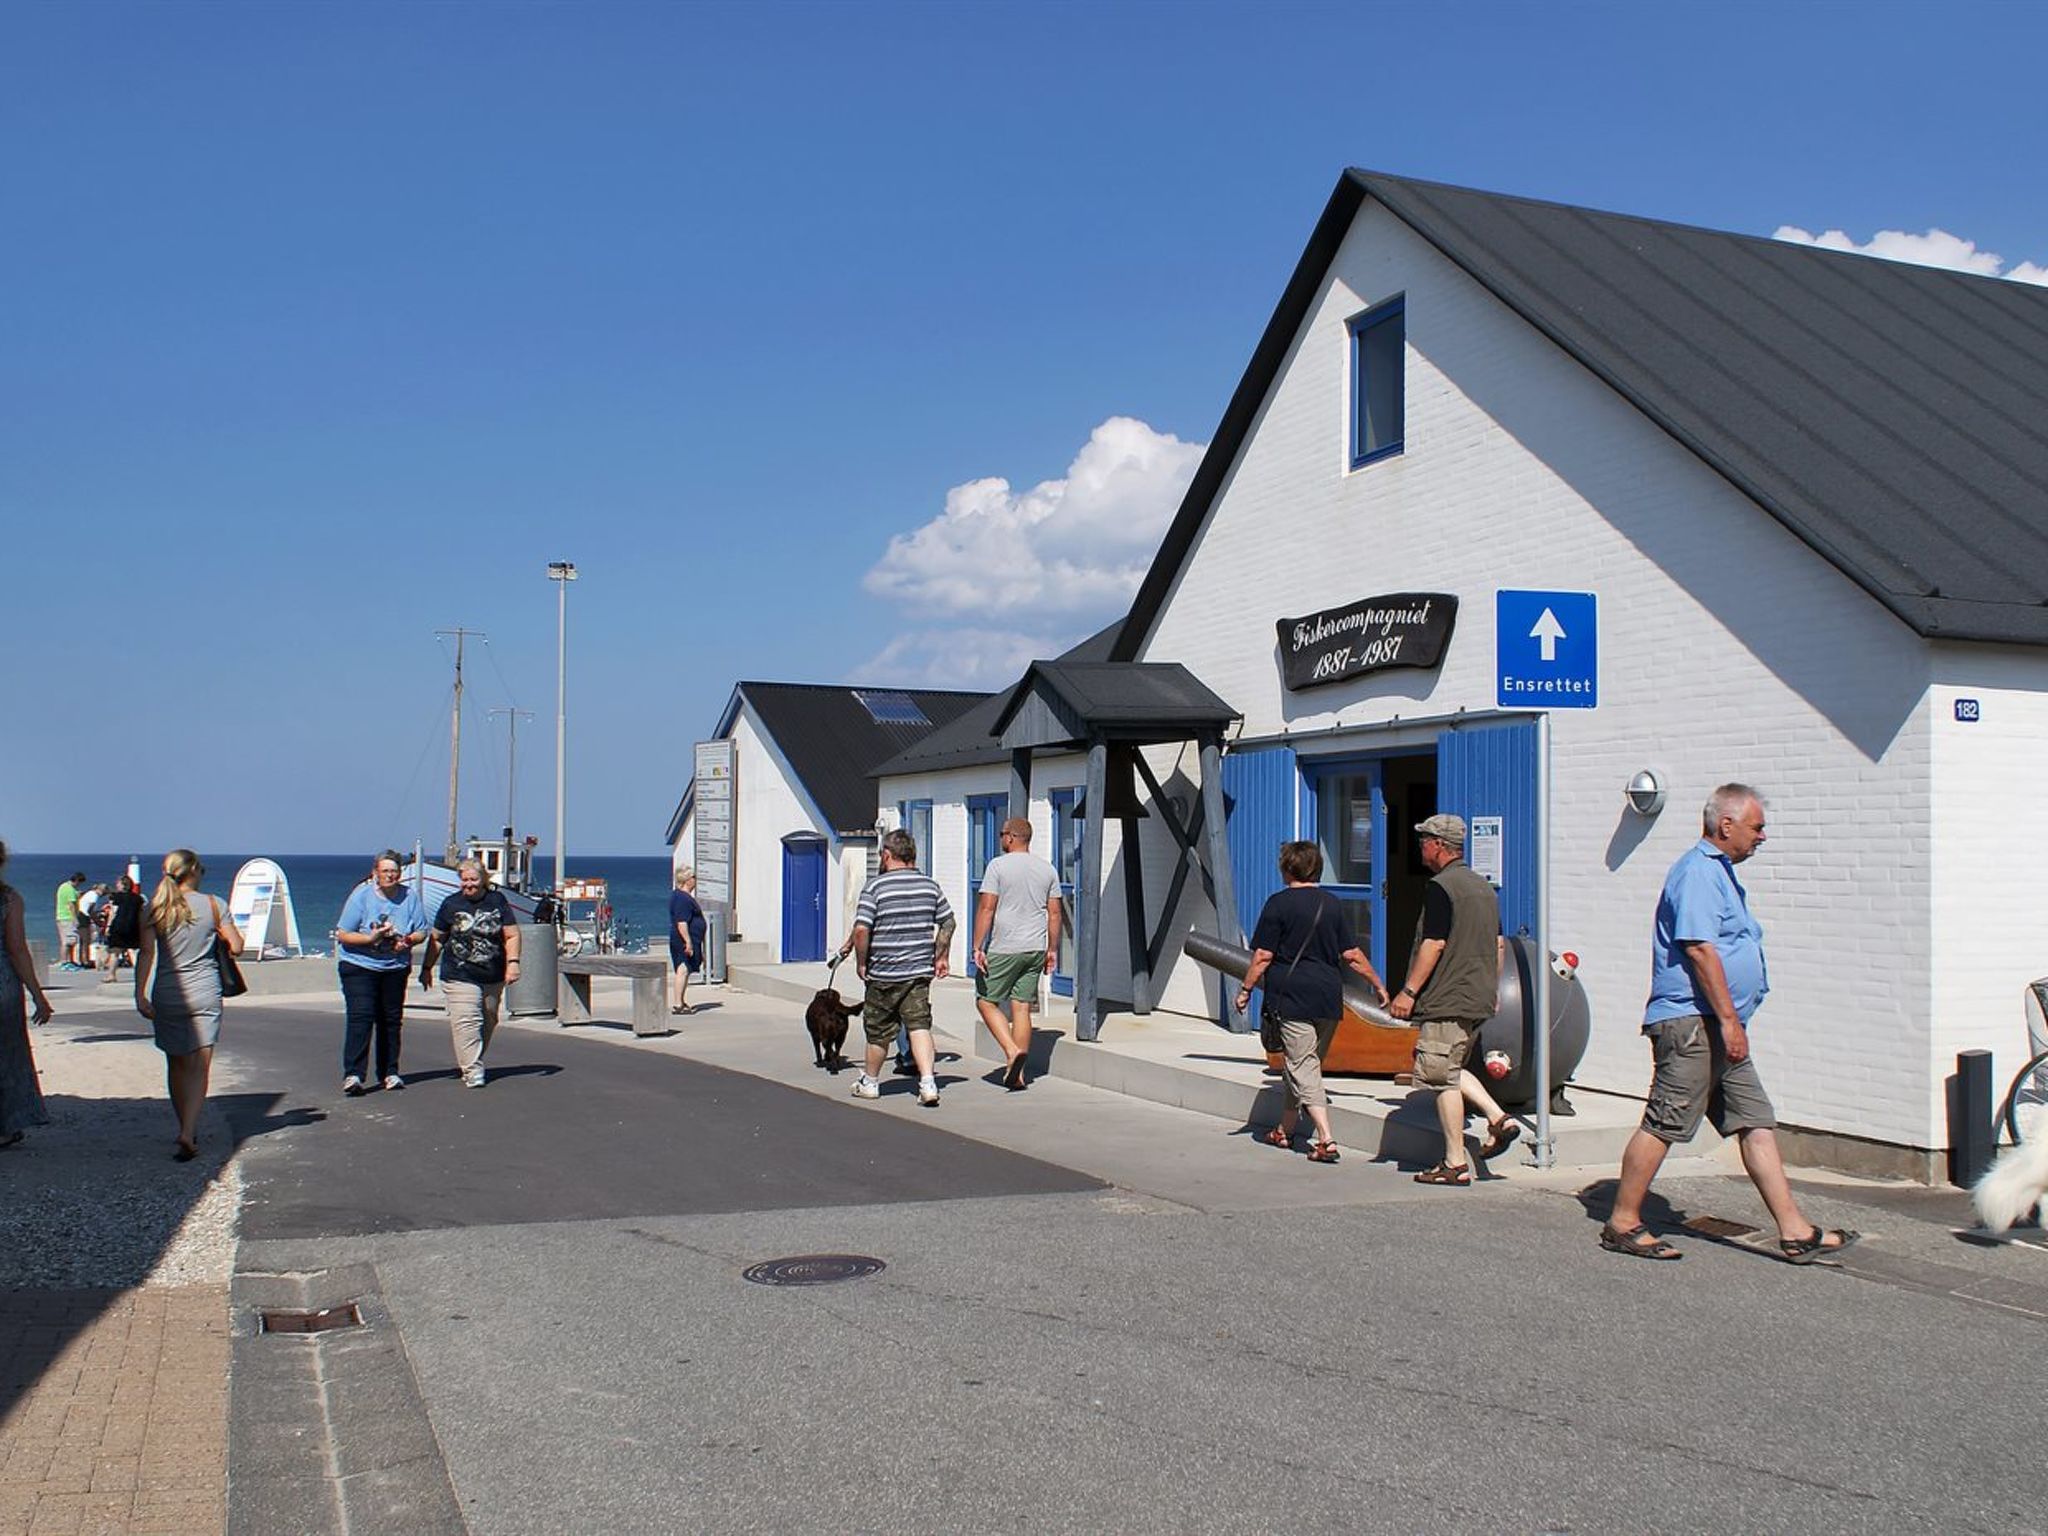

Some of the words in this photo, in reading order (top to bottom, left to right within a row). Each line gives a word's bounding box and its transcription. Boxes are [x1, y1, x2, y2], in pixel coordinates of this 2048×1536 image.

[1293, 600, 1431, 652] Fiskercompagniet
[1503, 676, 1591, 693] Ensrettet
[1956, 702, 1978, 718] 182
